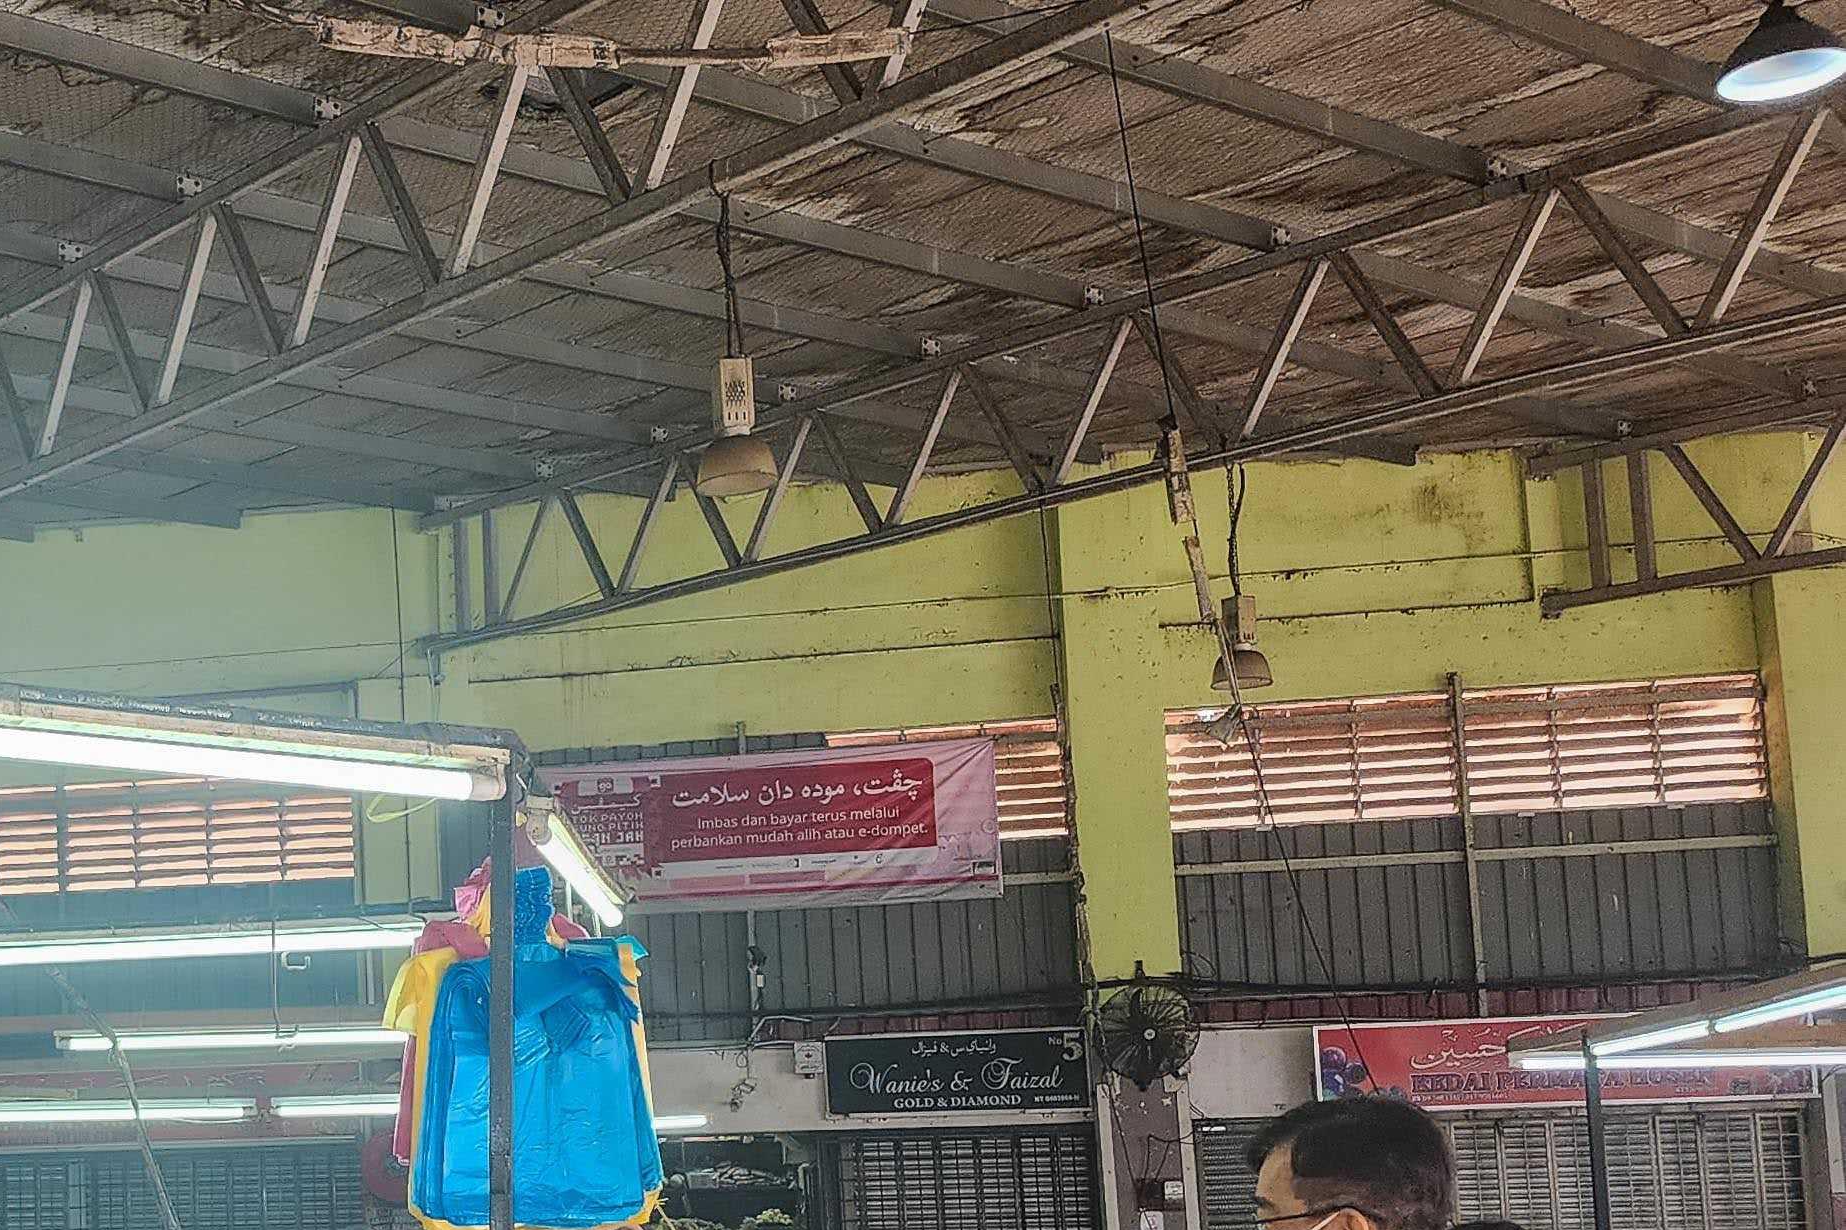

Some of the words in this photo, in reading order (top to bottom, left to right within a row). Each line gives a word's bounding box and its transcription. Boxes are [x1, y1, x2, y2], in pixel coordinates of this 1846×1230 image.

[672, 779, 750, 809] سلامت
[697, 814, 739, 831] Imbas
[740, 812, 767, 828] dan
[769, 810, 808, 830] bayar
[811, 808, 847, 823] terus
[849, 805, 900, 823] melalui
[670, 832, 744, 852] perbankan
[746, 828, 792, 844] mudah
[793, 827, 823, 842] alih
[824, 827, 856, 840] atau
[858, 821, 928, 842] e-dompet.
[1062, 1031, 1084, 1061] 5
[849, 1062, 945, 1095] Wanie's
[950, 1070, 973, 1091] &
[981, 1056, 1064, 1091] Faizal
[1410, 1072, 1491, 1094] KEDAI
[1496, 1068, 1623, 1092] PERMAA
[893, 1096, 936, 1109] GOLD
[937, 1096, 948, 1108] &
[949, 1094, 1022, 1108] DIAMOND
